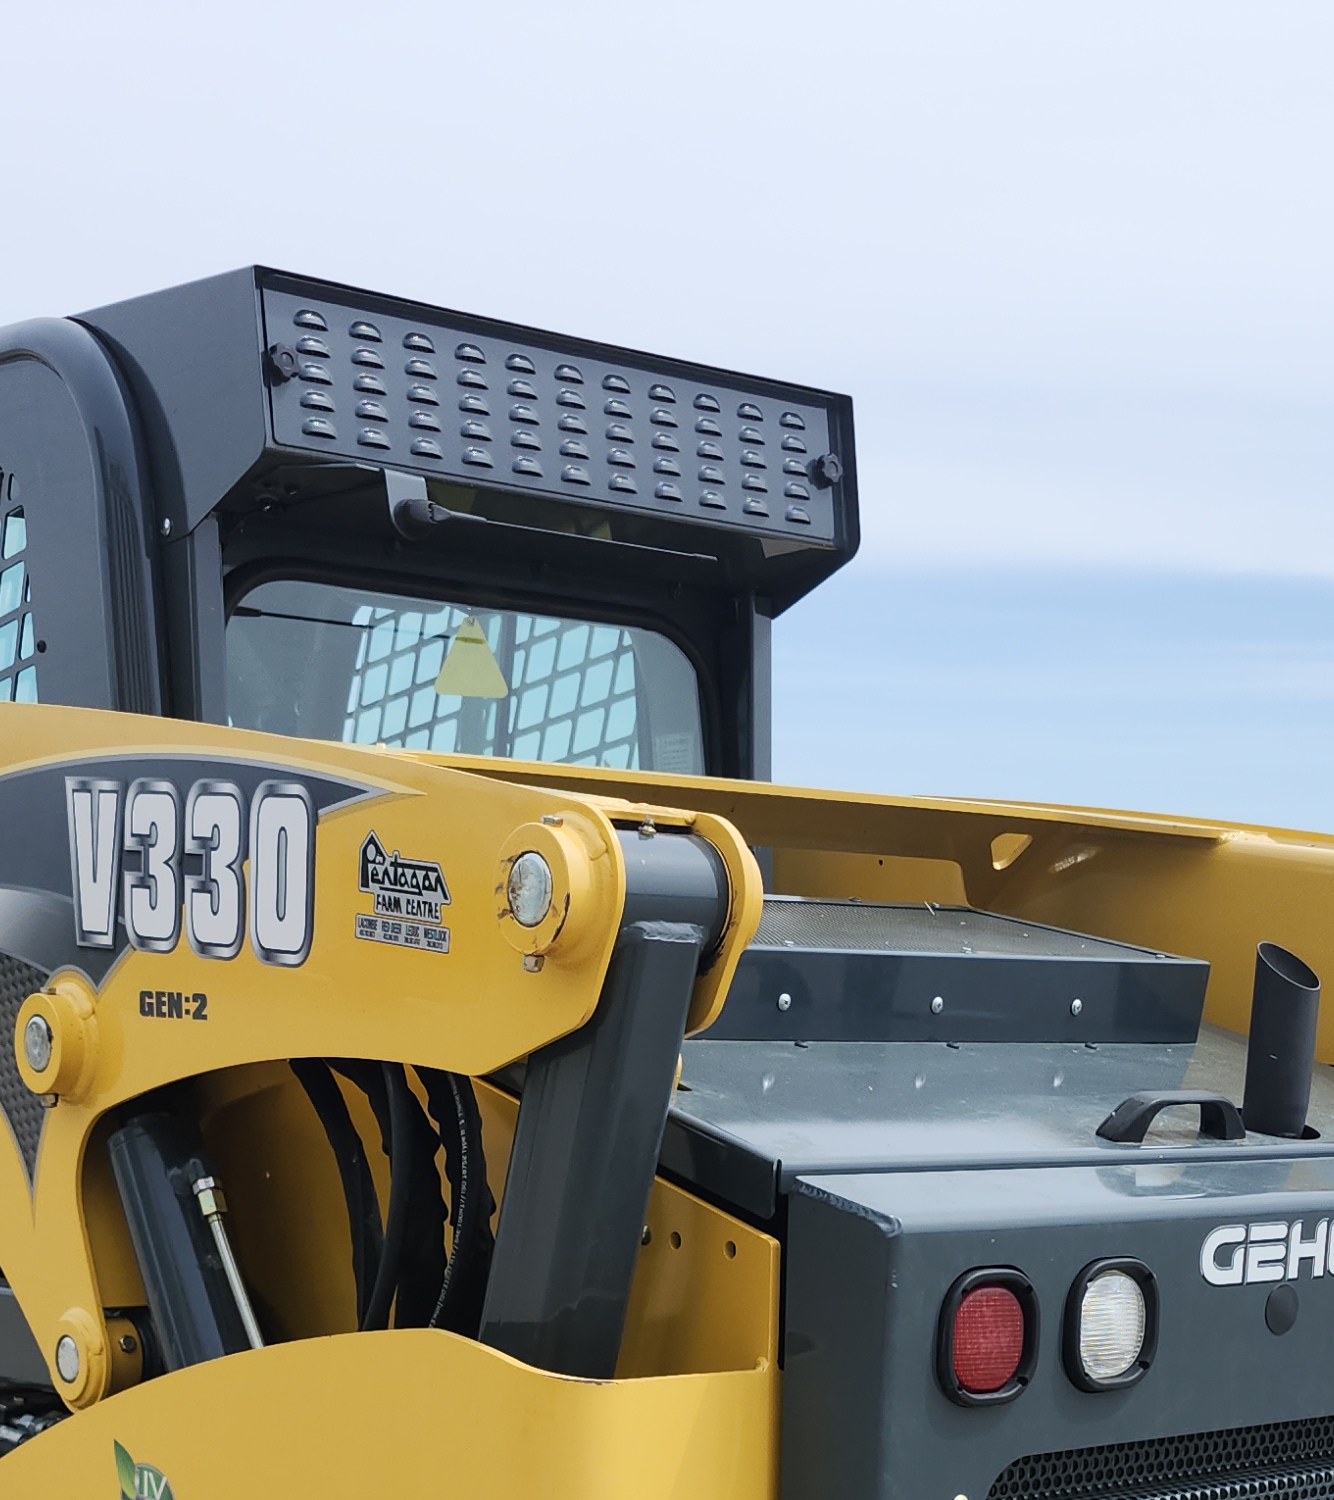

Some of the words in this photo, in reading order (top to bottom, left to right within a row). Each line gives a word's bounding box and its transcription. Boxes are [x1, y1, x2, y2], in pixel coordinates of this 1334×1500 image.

[64, 775, 319, 969] V330
[360, 833, 449, 901] Pentagon
[376, 893, 403, 914] FARM
[406, 897, 440, 920] CENTRE
[139, 990, 208, 1021] GEN:2
[143, 1470, 167, 1500] IV
